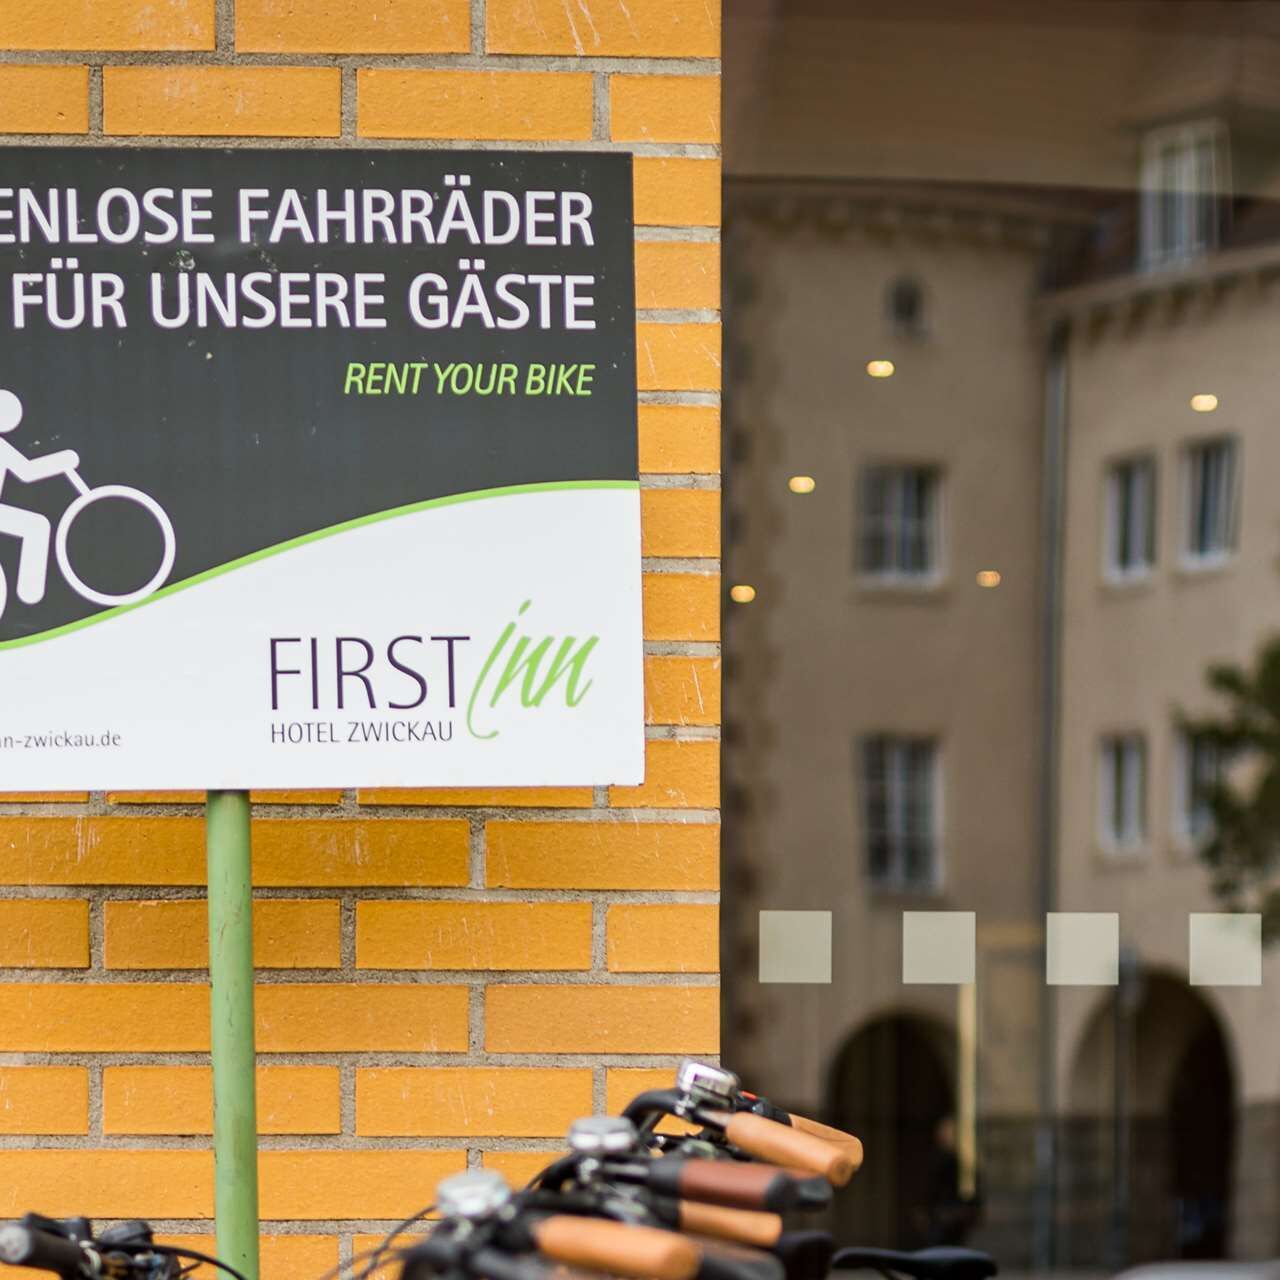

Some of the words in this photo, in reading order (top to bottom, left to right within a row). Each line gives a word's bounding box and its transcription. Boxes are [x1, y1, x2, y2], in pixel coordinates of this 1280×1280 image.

[238, 174, 595, 246] FAHRRÄDER
[12, 257, 128, 329] FÜR
[150, 272, 387, 329] UNSERE
[408, 258, 597, 330] GÄSTE
[343, 362, 429, 395] RENT
[433, 362, 519, 396] YOUR
[524, 363, 597, 396] BIKE
[269, 635, 471, 710] FIRST
[466, 599, 600, 740] inn
[271, 721, 341, 744] HOTEL
[346, 720, 453, 743] ZWICKAU
